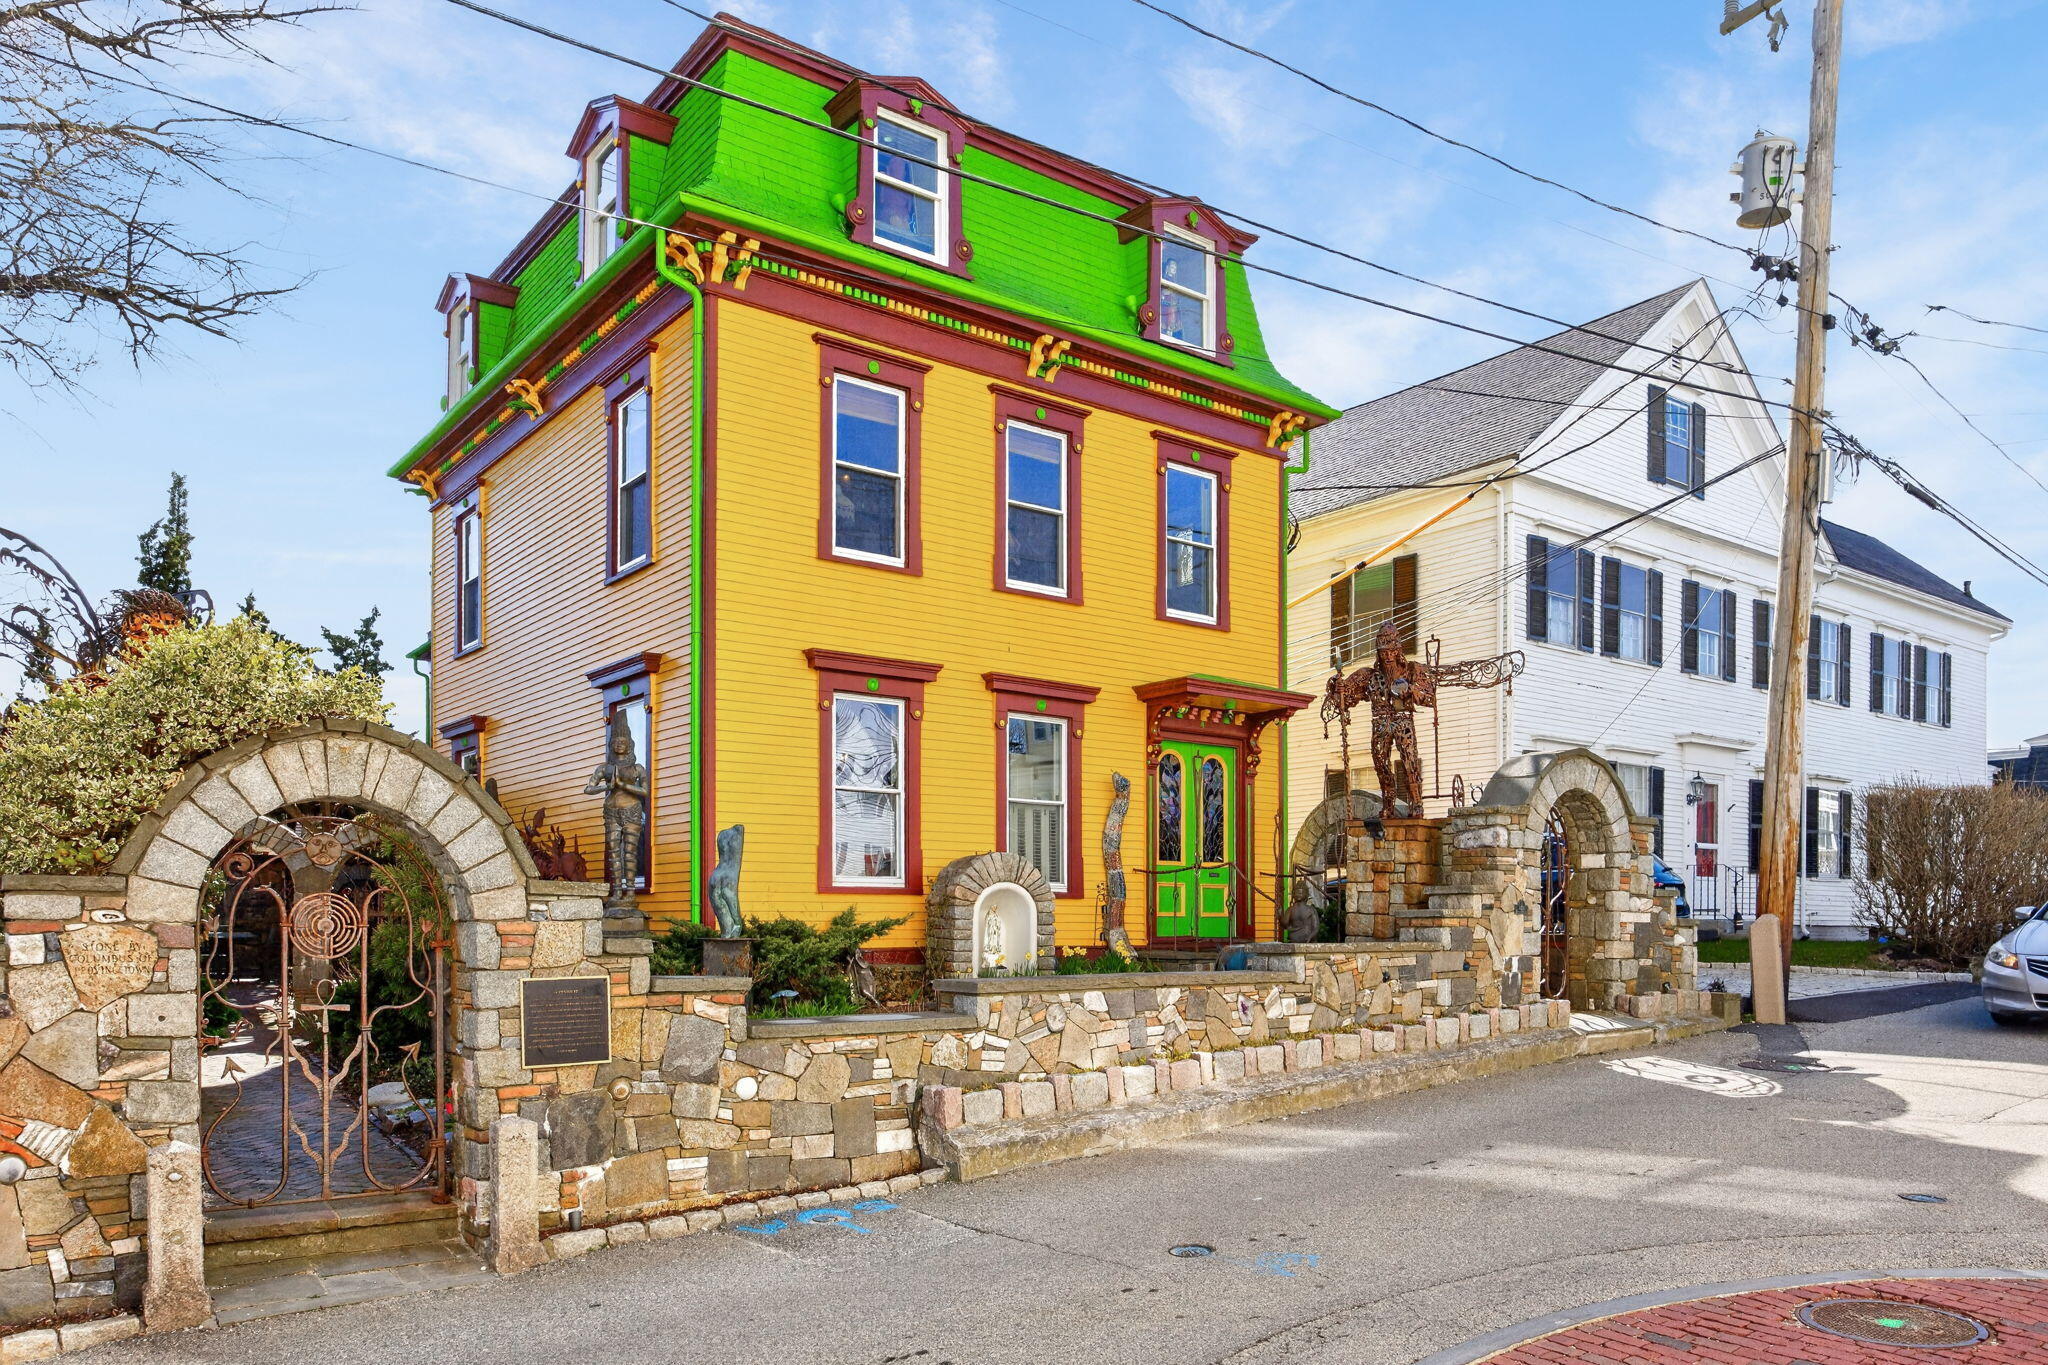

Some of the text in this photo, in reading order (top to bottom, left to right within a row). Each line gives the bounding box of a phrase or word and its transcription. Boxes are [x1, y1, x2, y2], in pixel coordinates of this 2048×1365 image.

[82, 942, 143, 953] STONE BY
[69, 953, 152, 964] COLUMBUS OF
